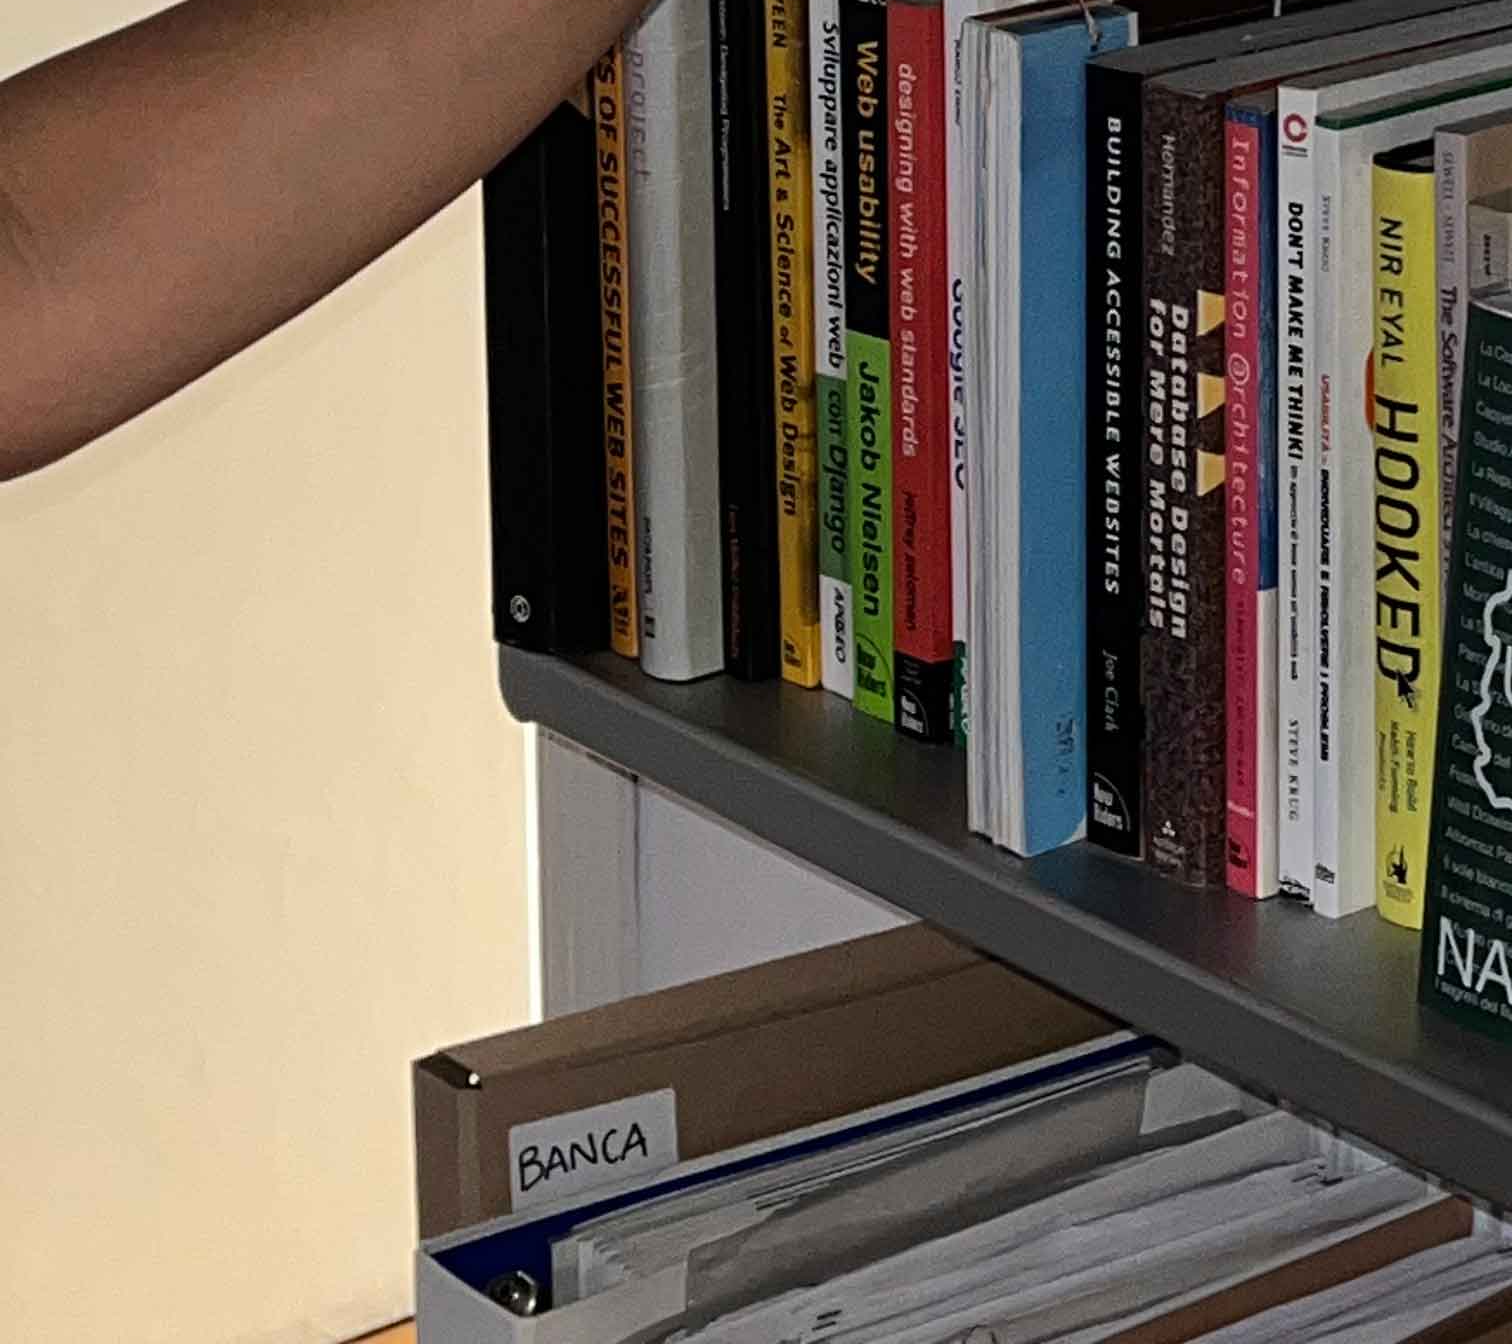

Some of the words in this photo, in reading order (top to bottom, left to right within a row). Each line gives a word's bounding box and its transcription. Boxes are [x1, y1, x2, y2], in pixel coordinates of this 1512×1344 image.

[595, 98, 620, 141] OF
[773, 93, 788, 132] The
[855, 41, 881, 117] Web
[773, 138, 793, 180] Art
[892, 63, 917, 195] designing
[775, 186, 792, 203] &
[854, 129, 882, 285] usability
[896, 202, 919, 259] with
[1105, 116, 1122, 260] BUILDING
[1159, 134, 1178, 256] Hernandez
[597, 149, 624, 374] SUCCESSFUL
[774, 213, 797, 318] Science
[898, 267, 919, 320] web
[1378, 217, 1405, 276] NIR
[1105, 269, 1122, 443] ACCESSIBLE
[1148, 297, 1168, 339] for
[1379, 287, 1407, 368] EYAL
[604, 381, 627, 458] WEB
[776, 355, 801, 416] Web
[855, 362, 883, 474] Jakob
[898, 329, 921, 458] standards
[1148, 369, 1167, 466] Mere
[1169, 304, 1189, 496] Database
[606, 465, 630, 568] SITES
[778, 423, 802, 518] Design
[858, 483, 885, 617] Nielsen
[1105, 452, 1123, 594] WEBSITES
[1148, 479, 1168, 629] Mortals
[1374, 394, 1422, 687] HOOKED
[1168, 505, 1190, 641] Design
[1102, 649, 1119, 680] Joe
[1103, 686, 1119, 732] Clark
[518, 1121, 652, 1193] BANCA
